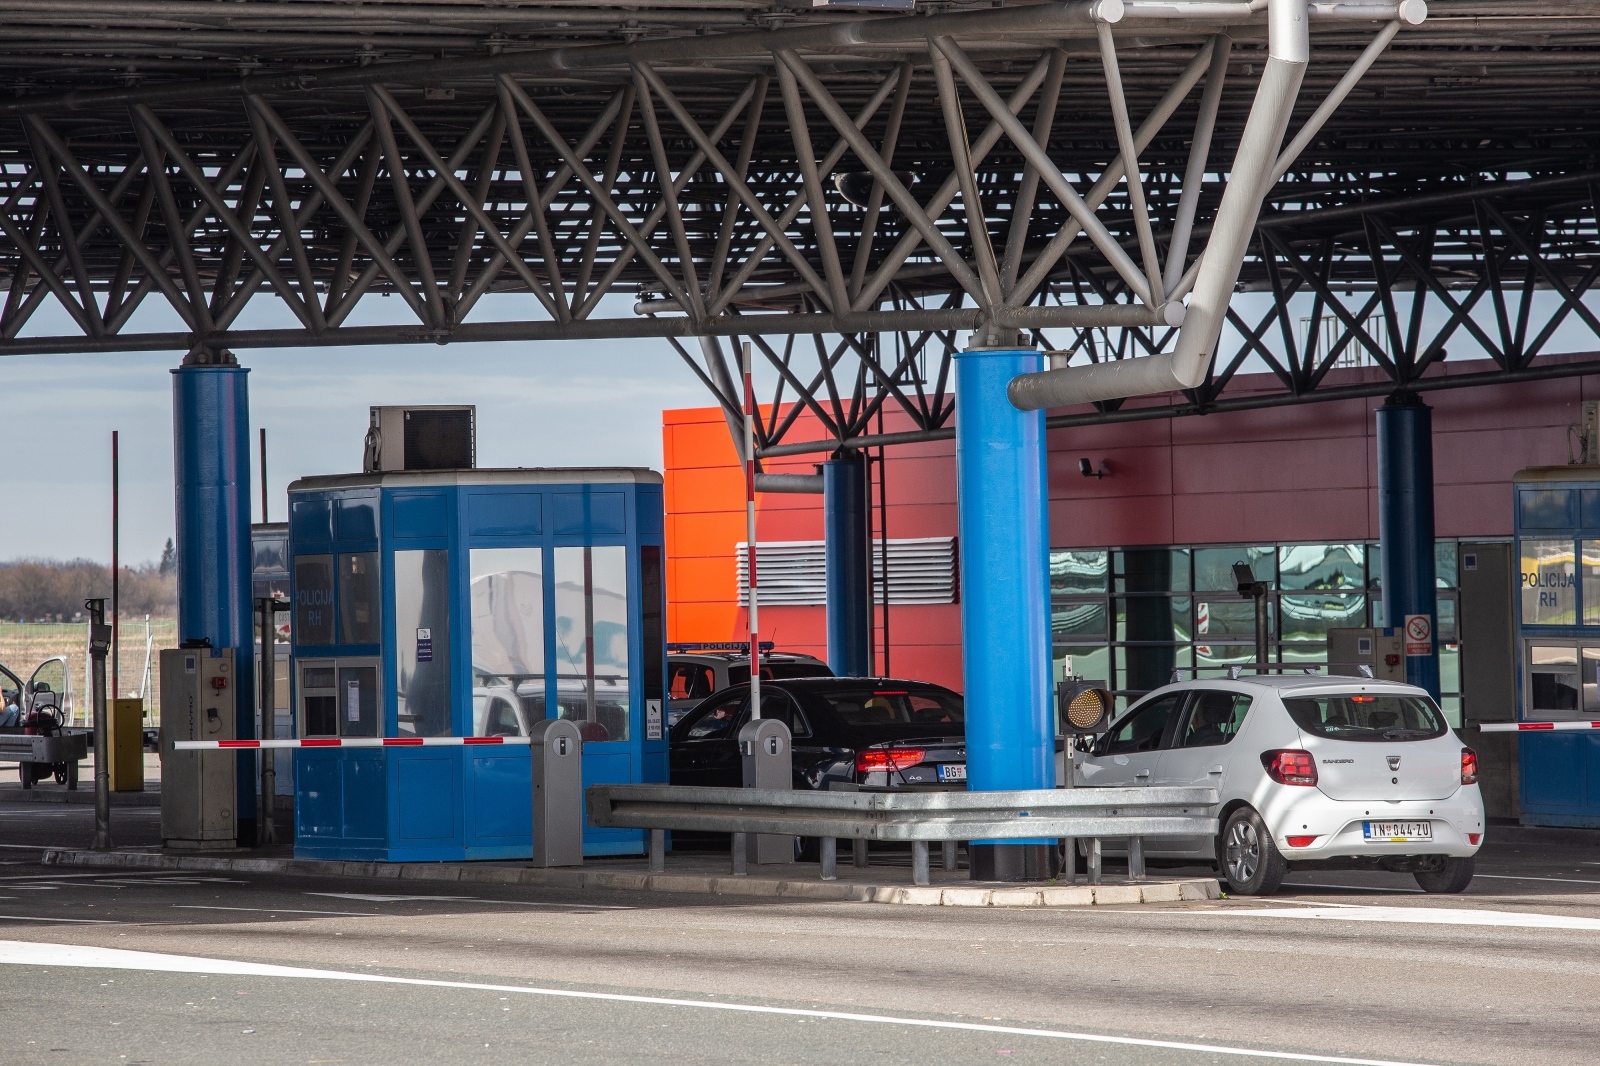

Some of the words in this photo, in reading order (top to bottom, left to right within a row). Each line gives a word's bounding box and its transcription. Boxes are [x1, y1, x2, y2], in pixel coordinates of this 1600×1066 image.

[1520, 572, 1576, 588] POLICIJA
[295, 589, 335, 606] POLICIJA
[1540, 591, 1557, 607] RH
[308, 610, 322, 627] RH
[945, 766, 957, 778] BG
[1373, 823, 1386, 837] IN
